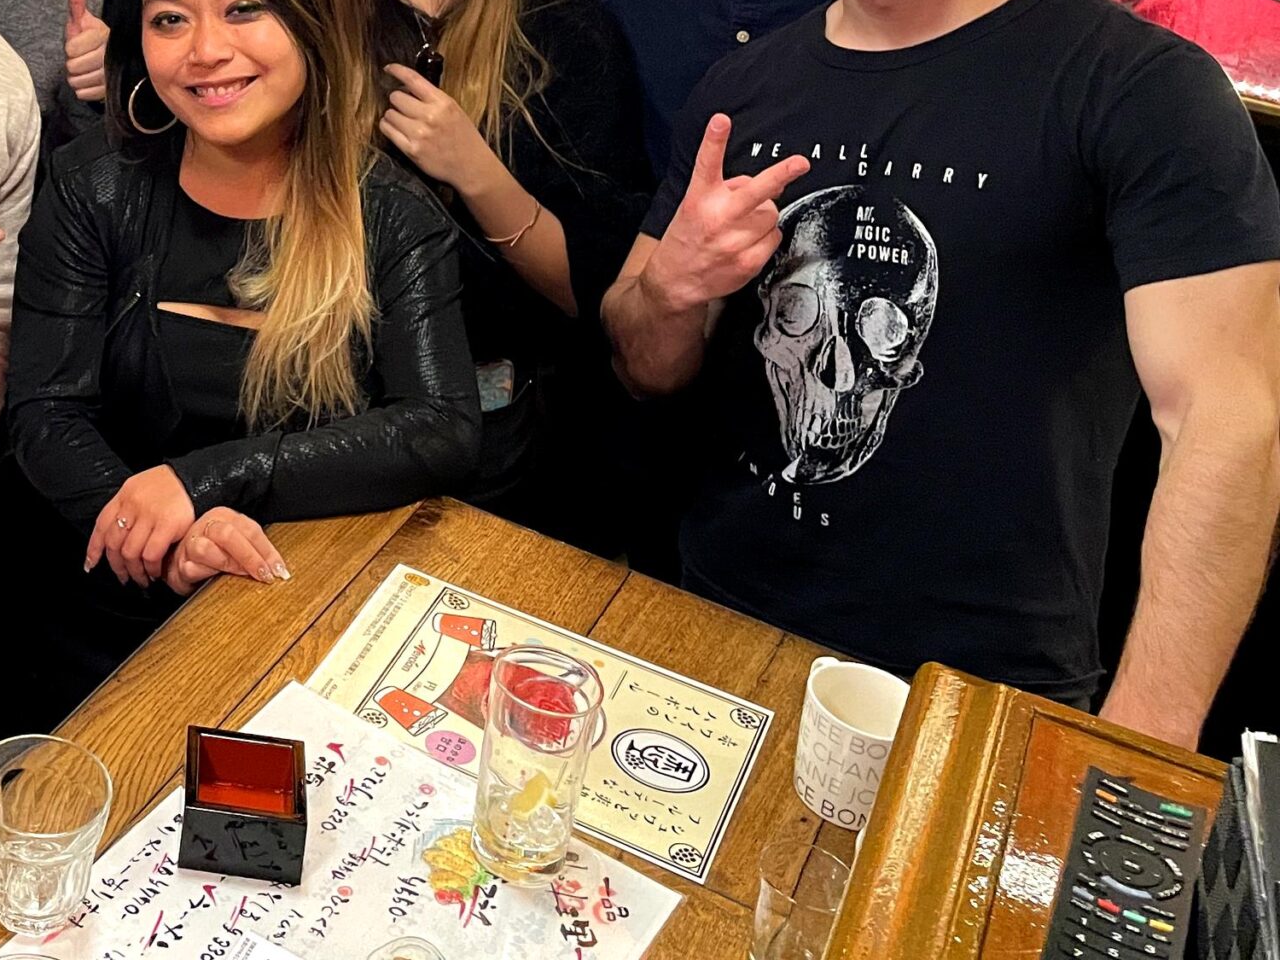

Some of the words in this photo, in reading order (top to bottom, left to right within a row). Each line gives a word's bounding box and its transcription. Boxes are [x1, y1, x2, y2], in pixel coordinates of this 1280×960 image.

[751, 142, 781, 158] WE
[811, 143, 868, 160] ALL
[858, 161, 989, 190] CARRY
[629, 682, 717, 721] ハイボール
[647, 707, 738, 747] 赤ワインの
[603, 779, 700, 824] フルーティな
[475, 871, 507, 925] フライ
[600, 877, 629, 921] 一品
